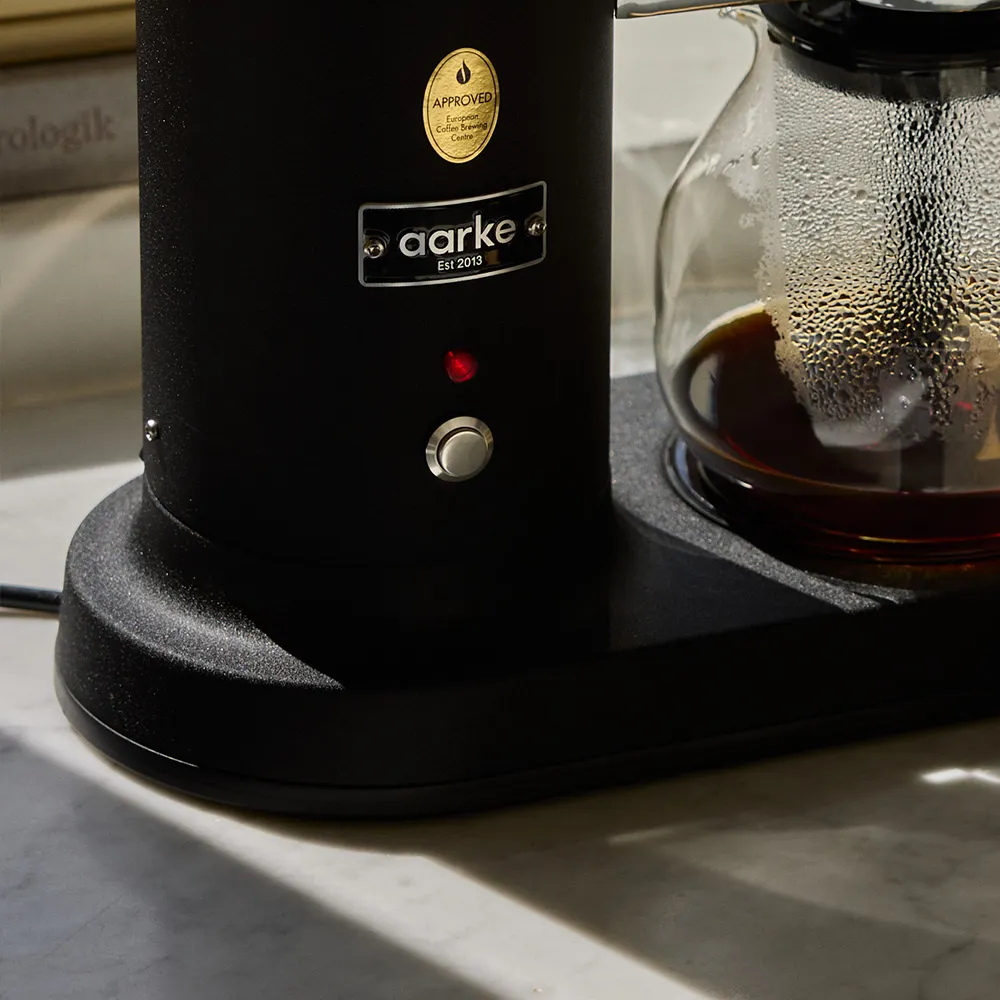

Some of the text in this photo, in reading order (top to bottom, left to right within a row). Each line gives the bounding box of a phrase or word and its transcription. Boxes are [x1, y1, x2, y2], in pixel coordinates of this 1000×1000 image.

[432, 92, 492, 108] APPROVED
[446, 113, 479, 123] European
[436, 121, 488, 134] Coffee Brewing
[451, 133, 474, 142] Centre
[399, 214, 517, 257] aarke
[437, 255, 483, 271] Est 2013
